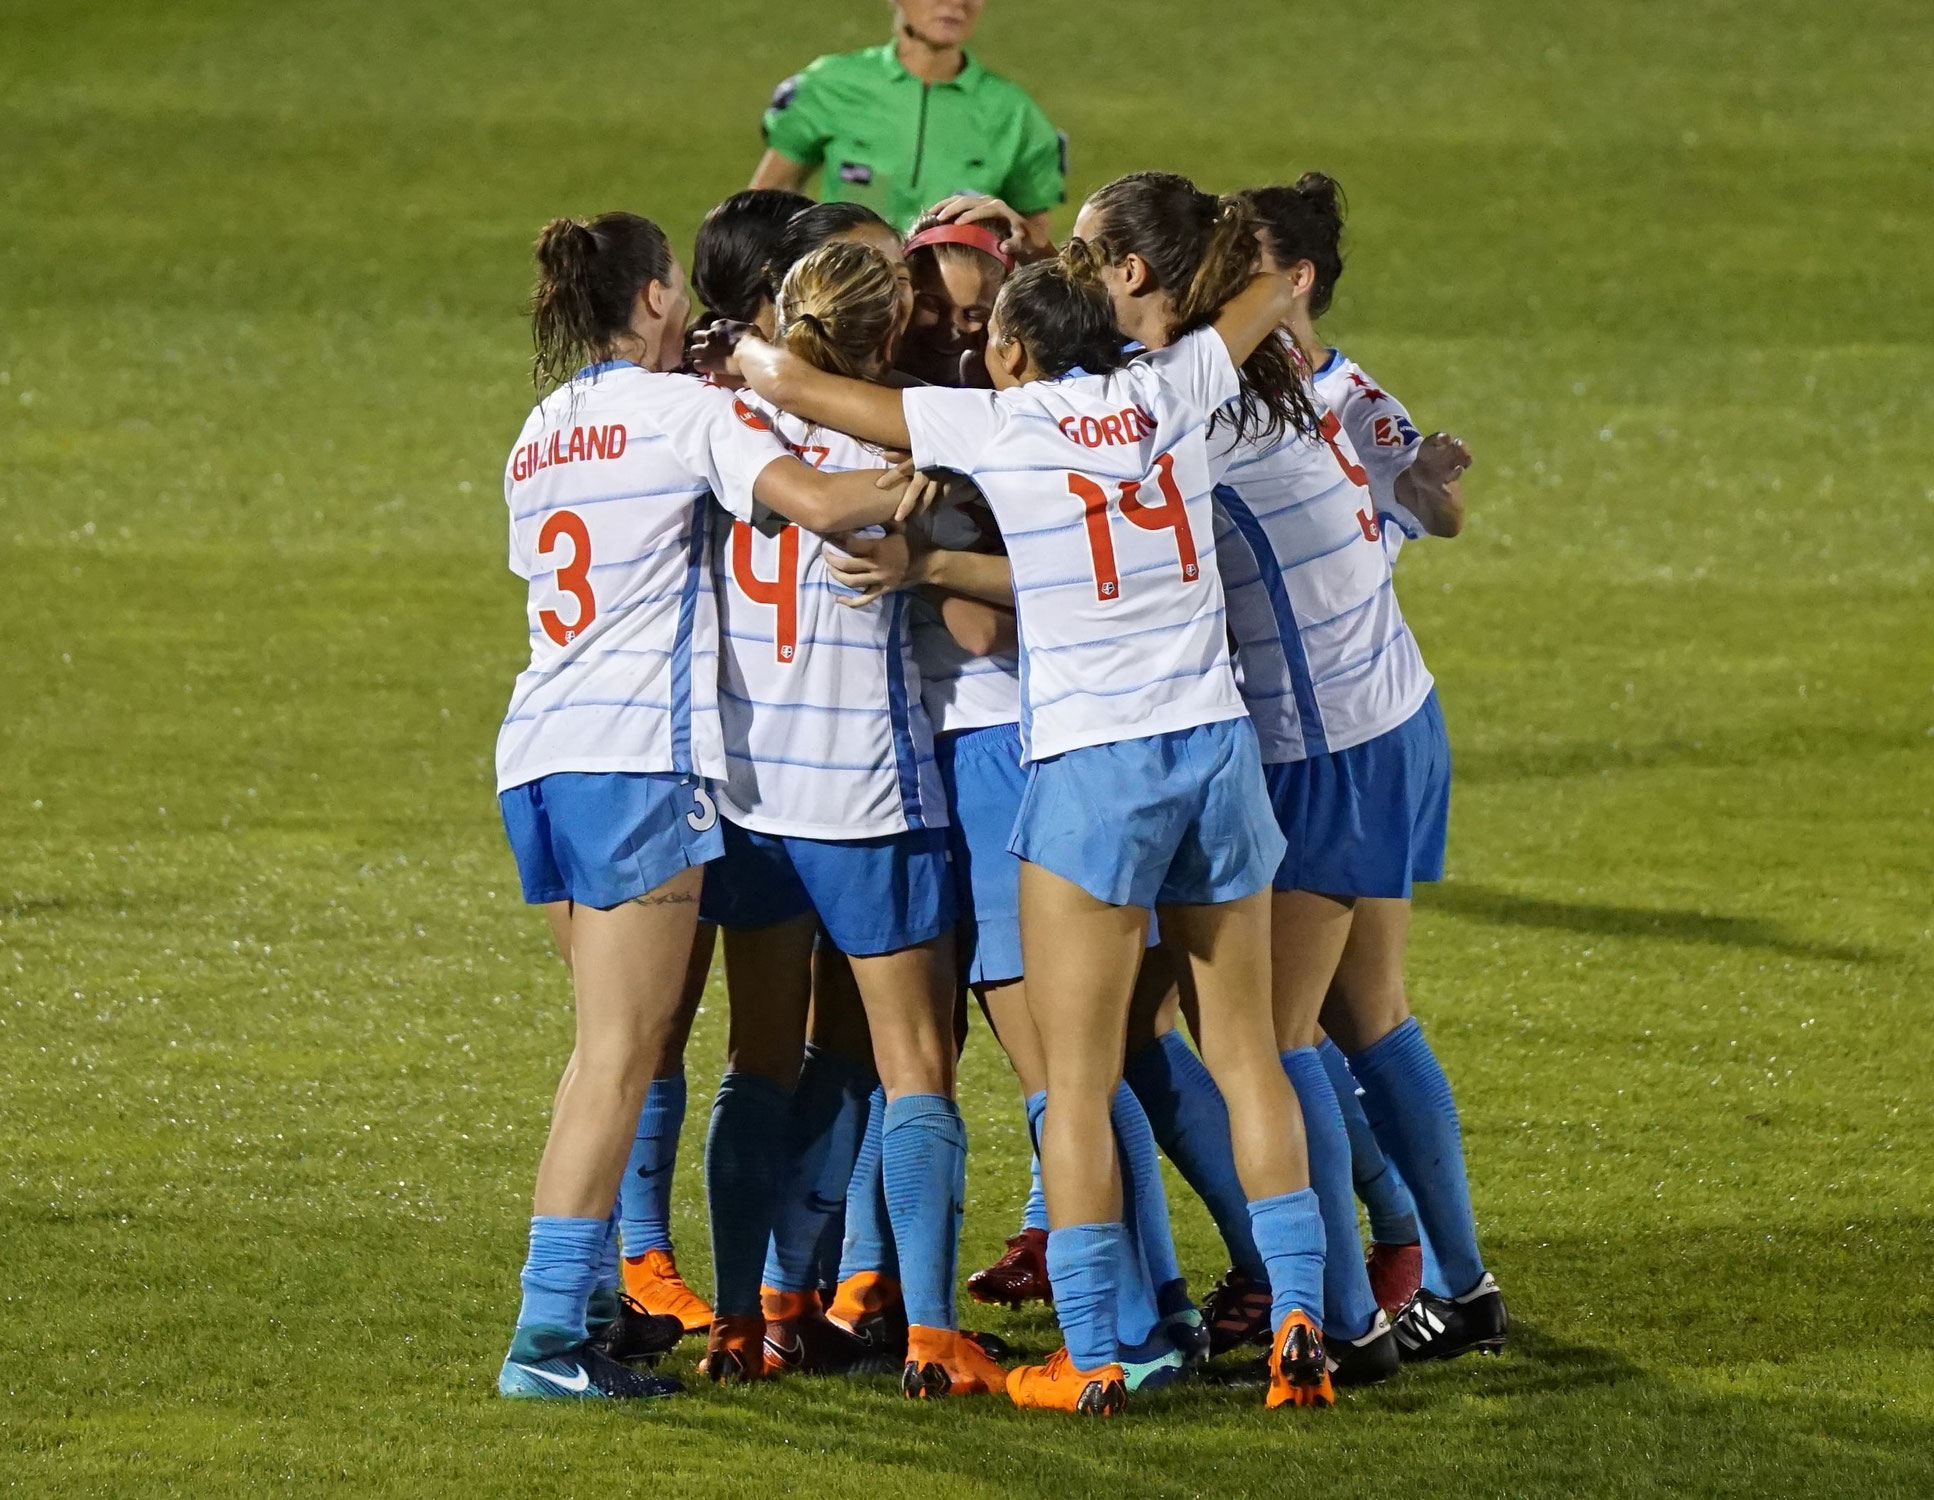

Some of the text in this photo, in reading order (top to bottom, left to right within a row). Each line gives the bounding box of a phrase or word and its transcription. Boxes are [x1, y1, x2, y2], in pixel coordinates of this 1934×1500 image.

[538, 510, 597, 648] 3
[732, 519, 800, 664] 4
[1067, 452, 1199, 601] 14
[680, 778, 718, 833] 3
